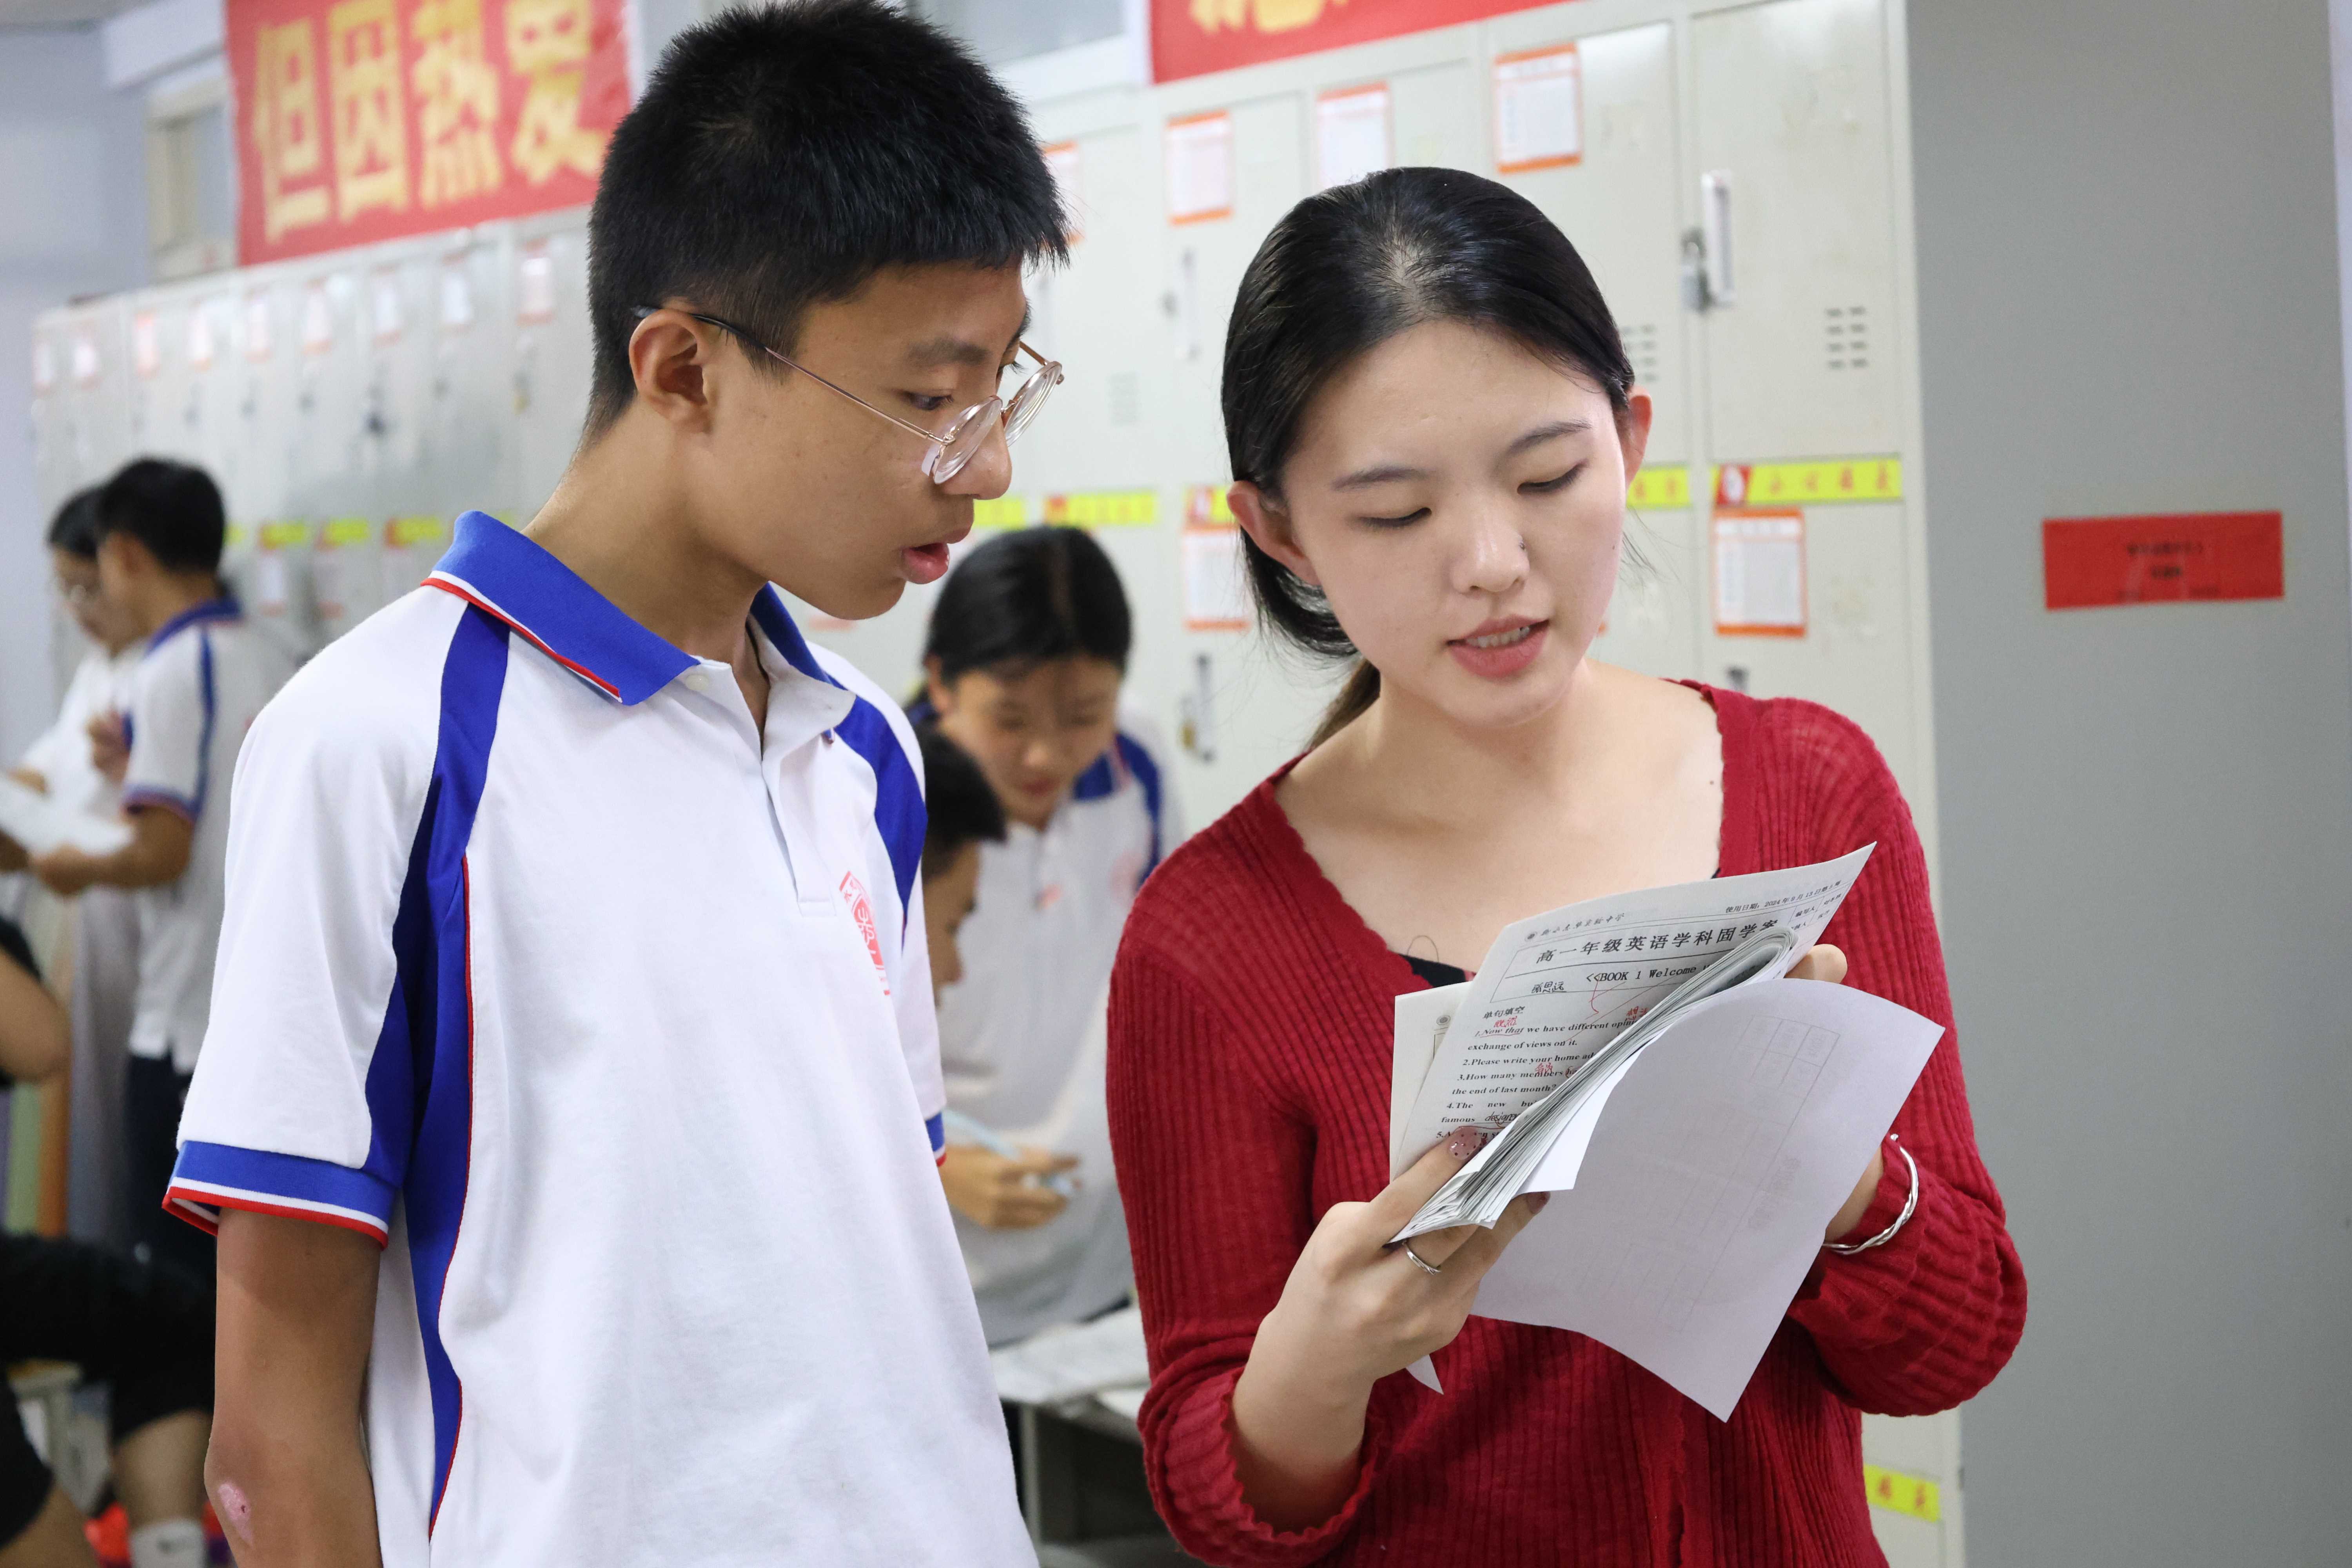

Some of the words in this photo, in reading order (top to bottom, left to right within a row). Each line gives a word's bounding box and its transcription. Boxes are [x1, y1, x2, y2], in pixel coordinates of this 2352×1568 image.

[252, 0, 608, 243] 但因热爱
[1635, 971, 1642, 979] 1
[1649, 967, 1697, 978] Welcome
[1483, 1006, 1525, 1019] 单句填空
[1568, 1022, 1609, 1031] different
[1520, 1084, 1556, 1093] month?
